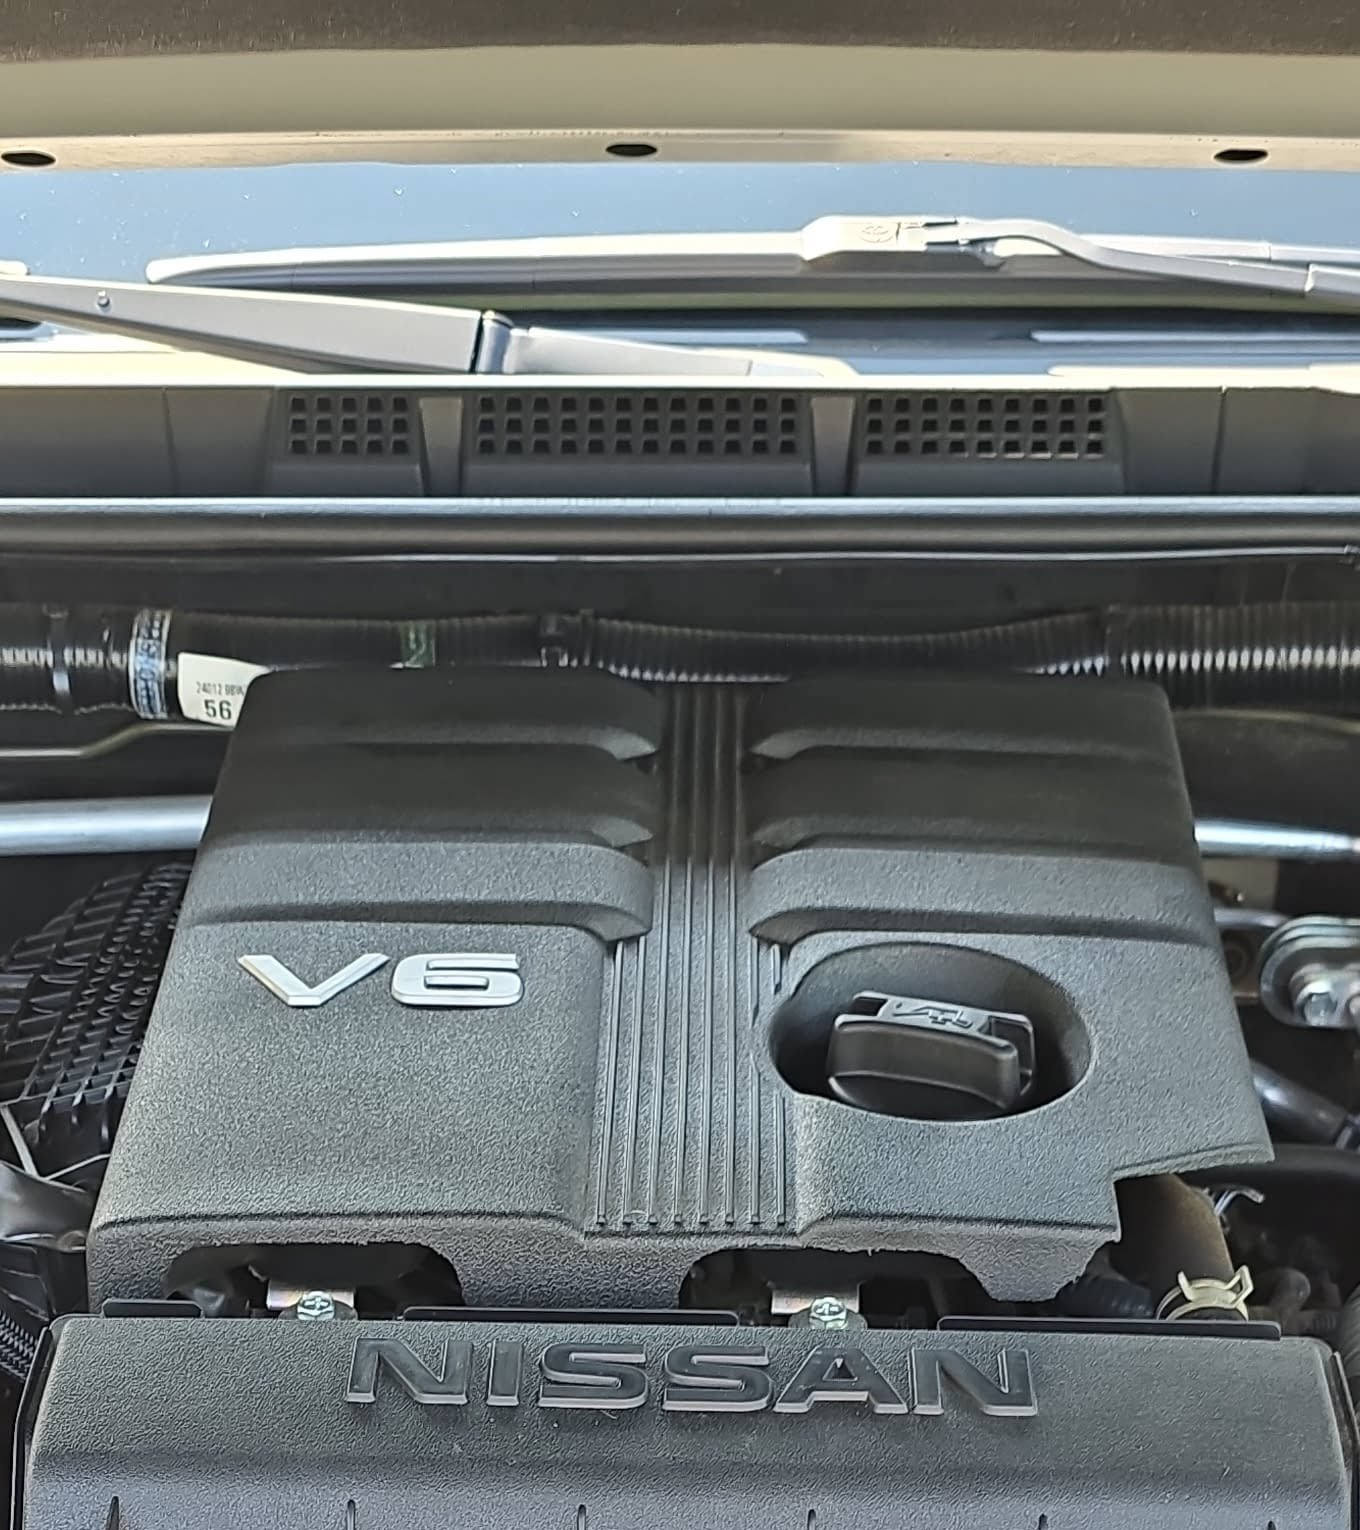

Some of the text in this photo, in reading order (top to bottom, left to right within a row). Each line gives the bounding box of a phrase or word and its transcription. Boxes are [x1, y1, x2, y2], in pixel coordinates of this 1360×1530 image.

[204, 699, 233, 720] 56
[238, 953, 525, 1007] V6
[346, 1337, 1039, 1416] NISSAN
